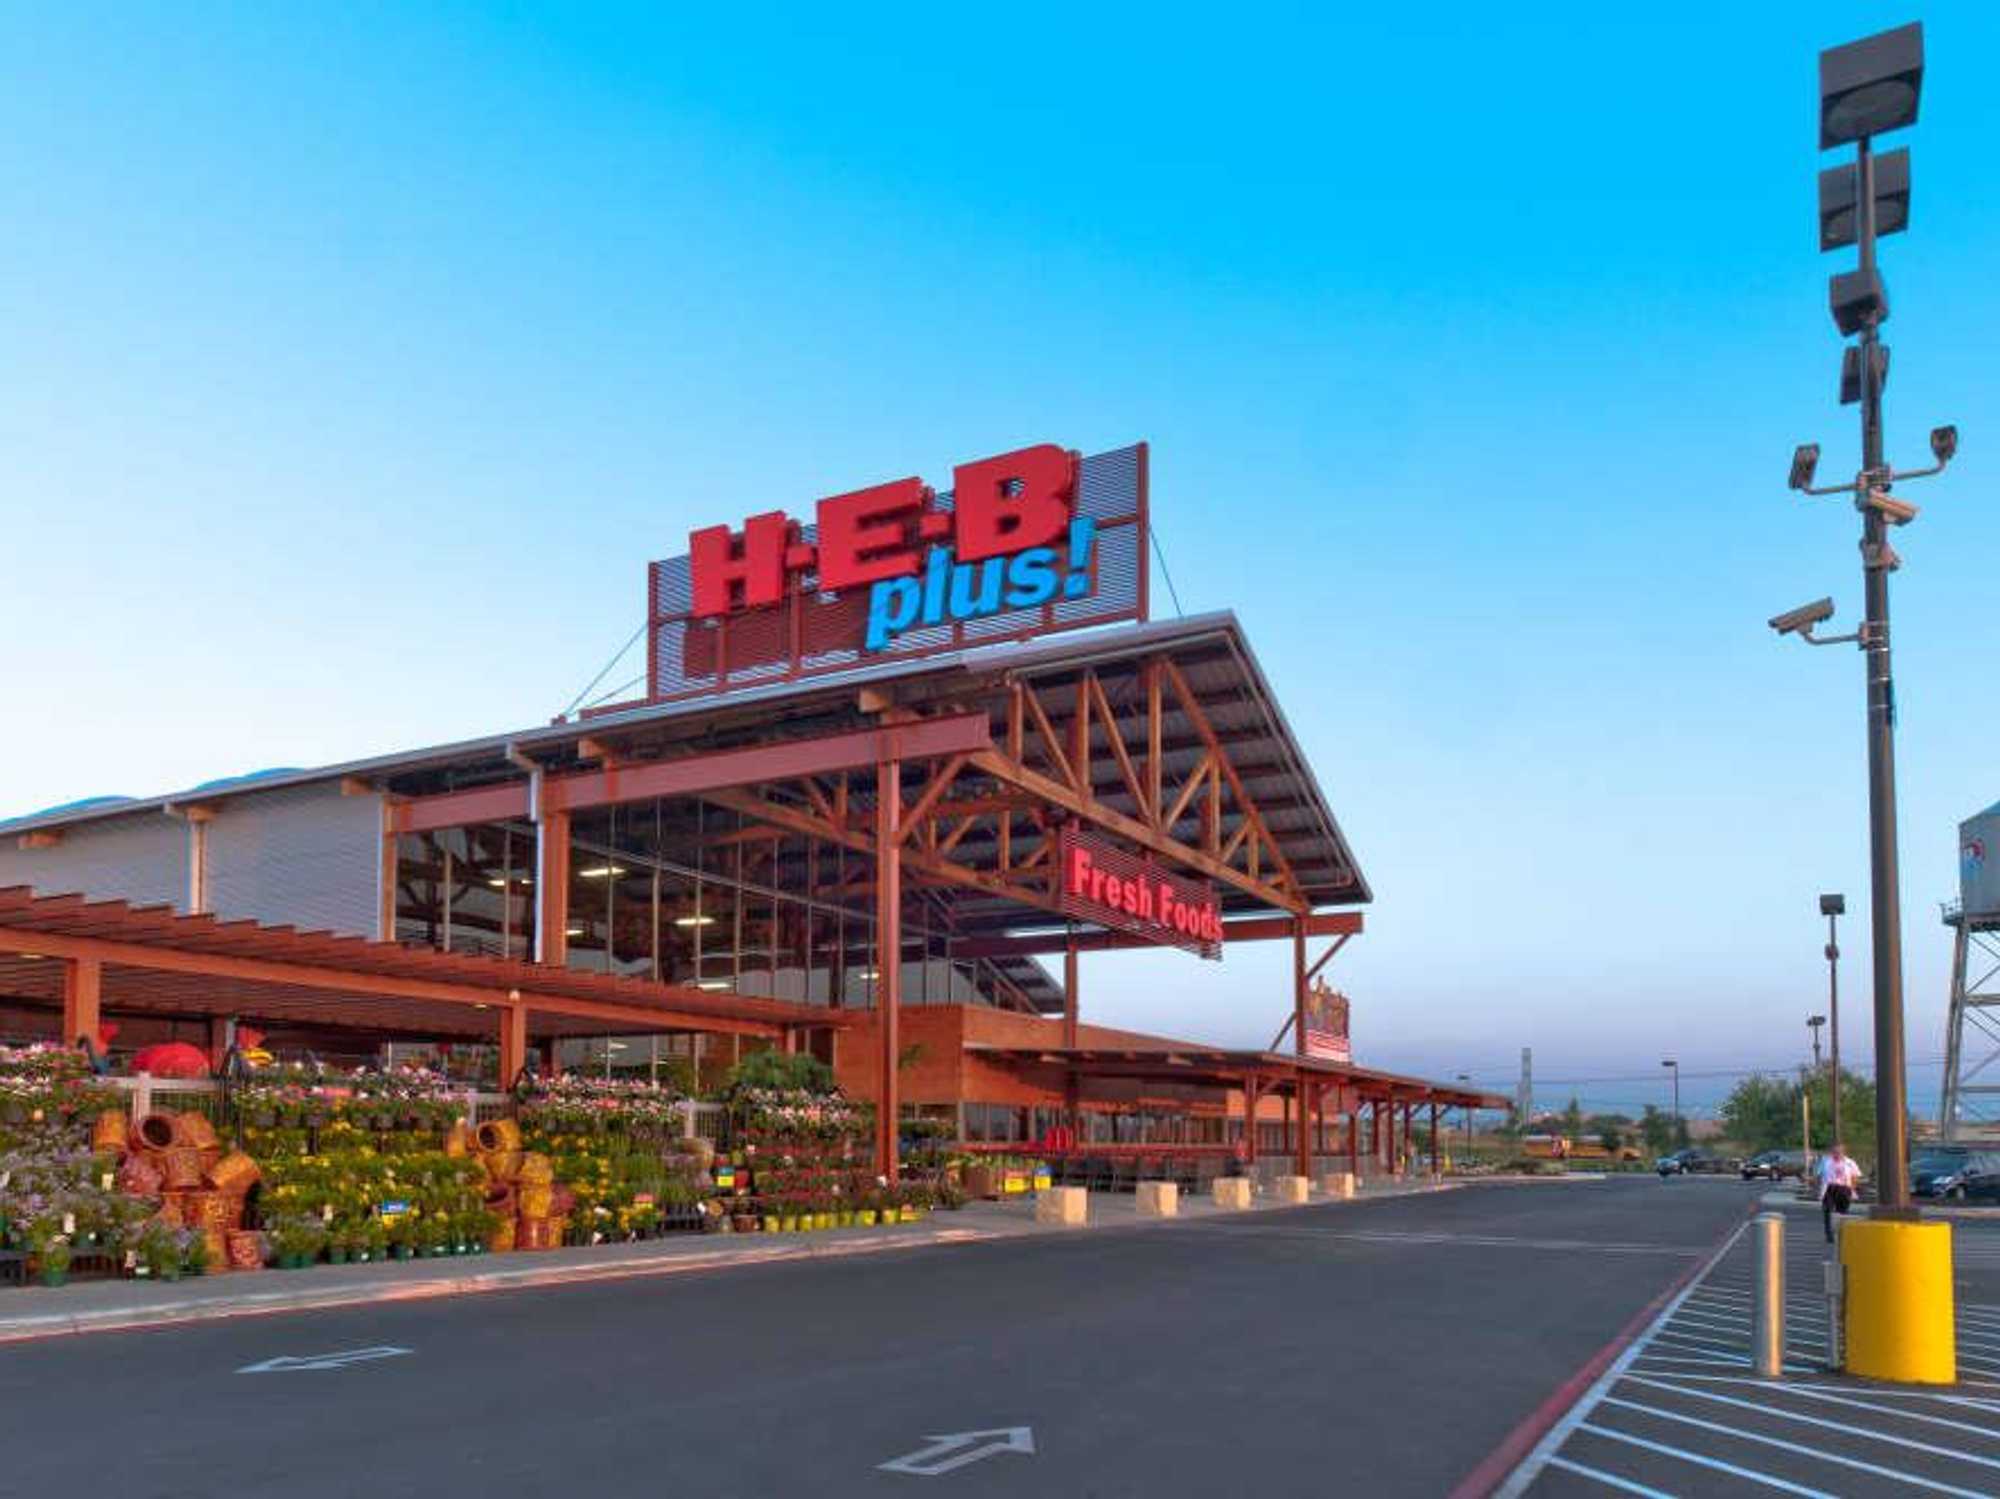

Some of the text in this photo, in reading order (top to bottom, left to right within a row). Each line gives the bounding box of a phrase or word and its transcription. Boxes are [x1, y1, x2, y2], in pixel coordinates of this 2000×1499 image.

[866, 516, 1095, 651] plus!
[1070, 848, 1223, 940] Fresh Foods
